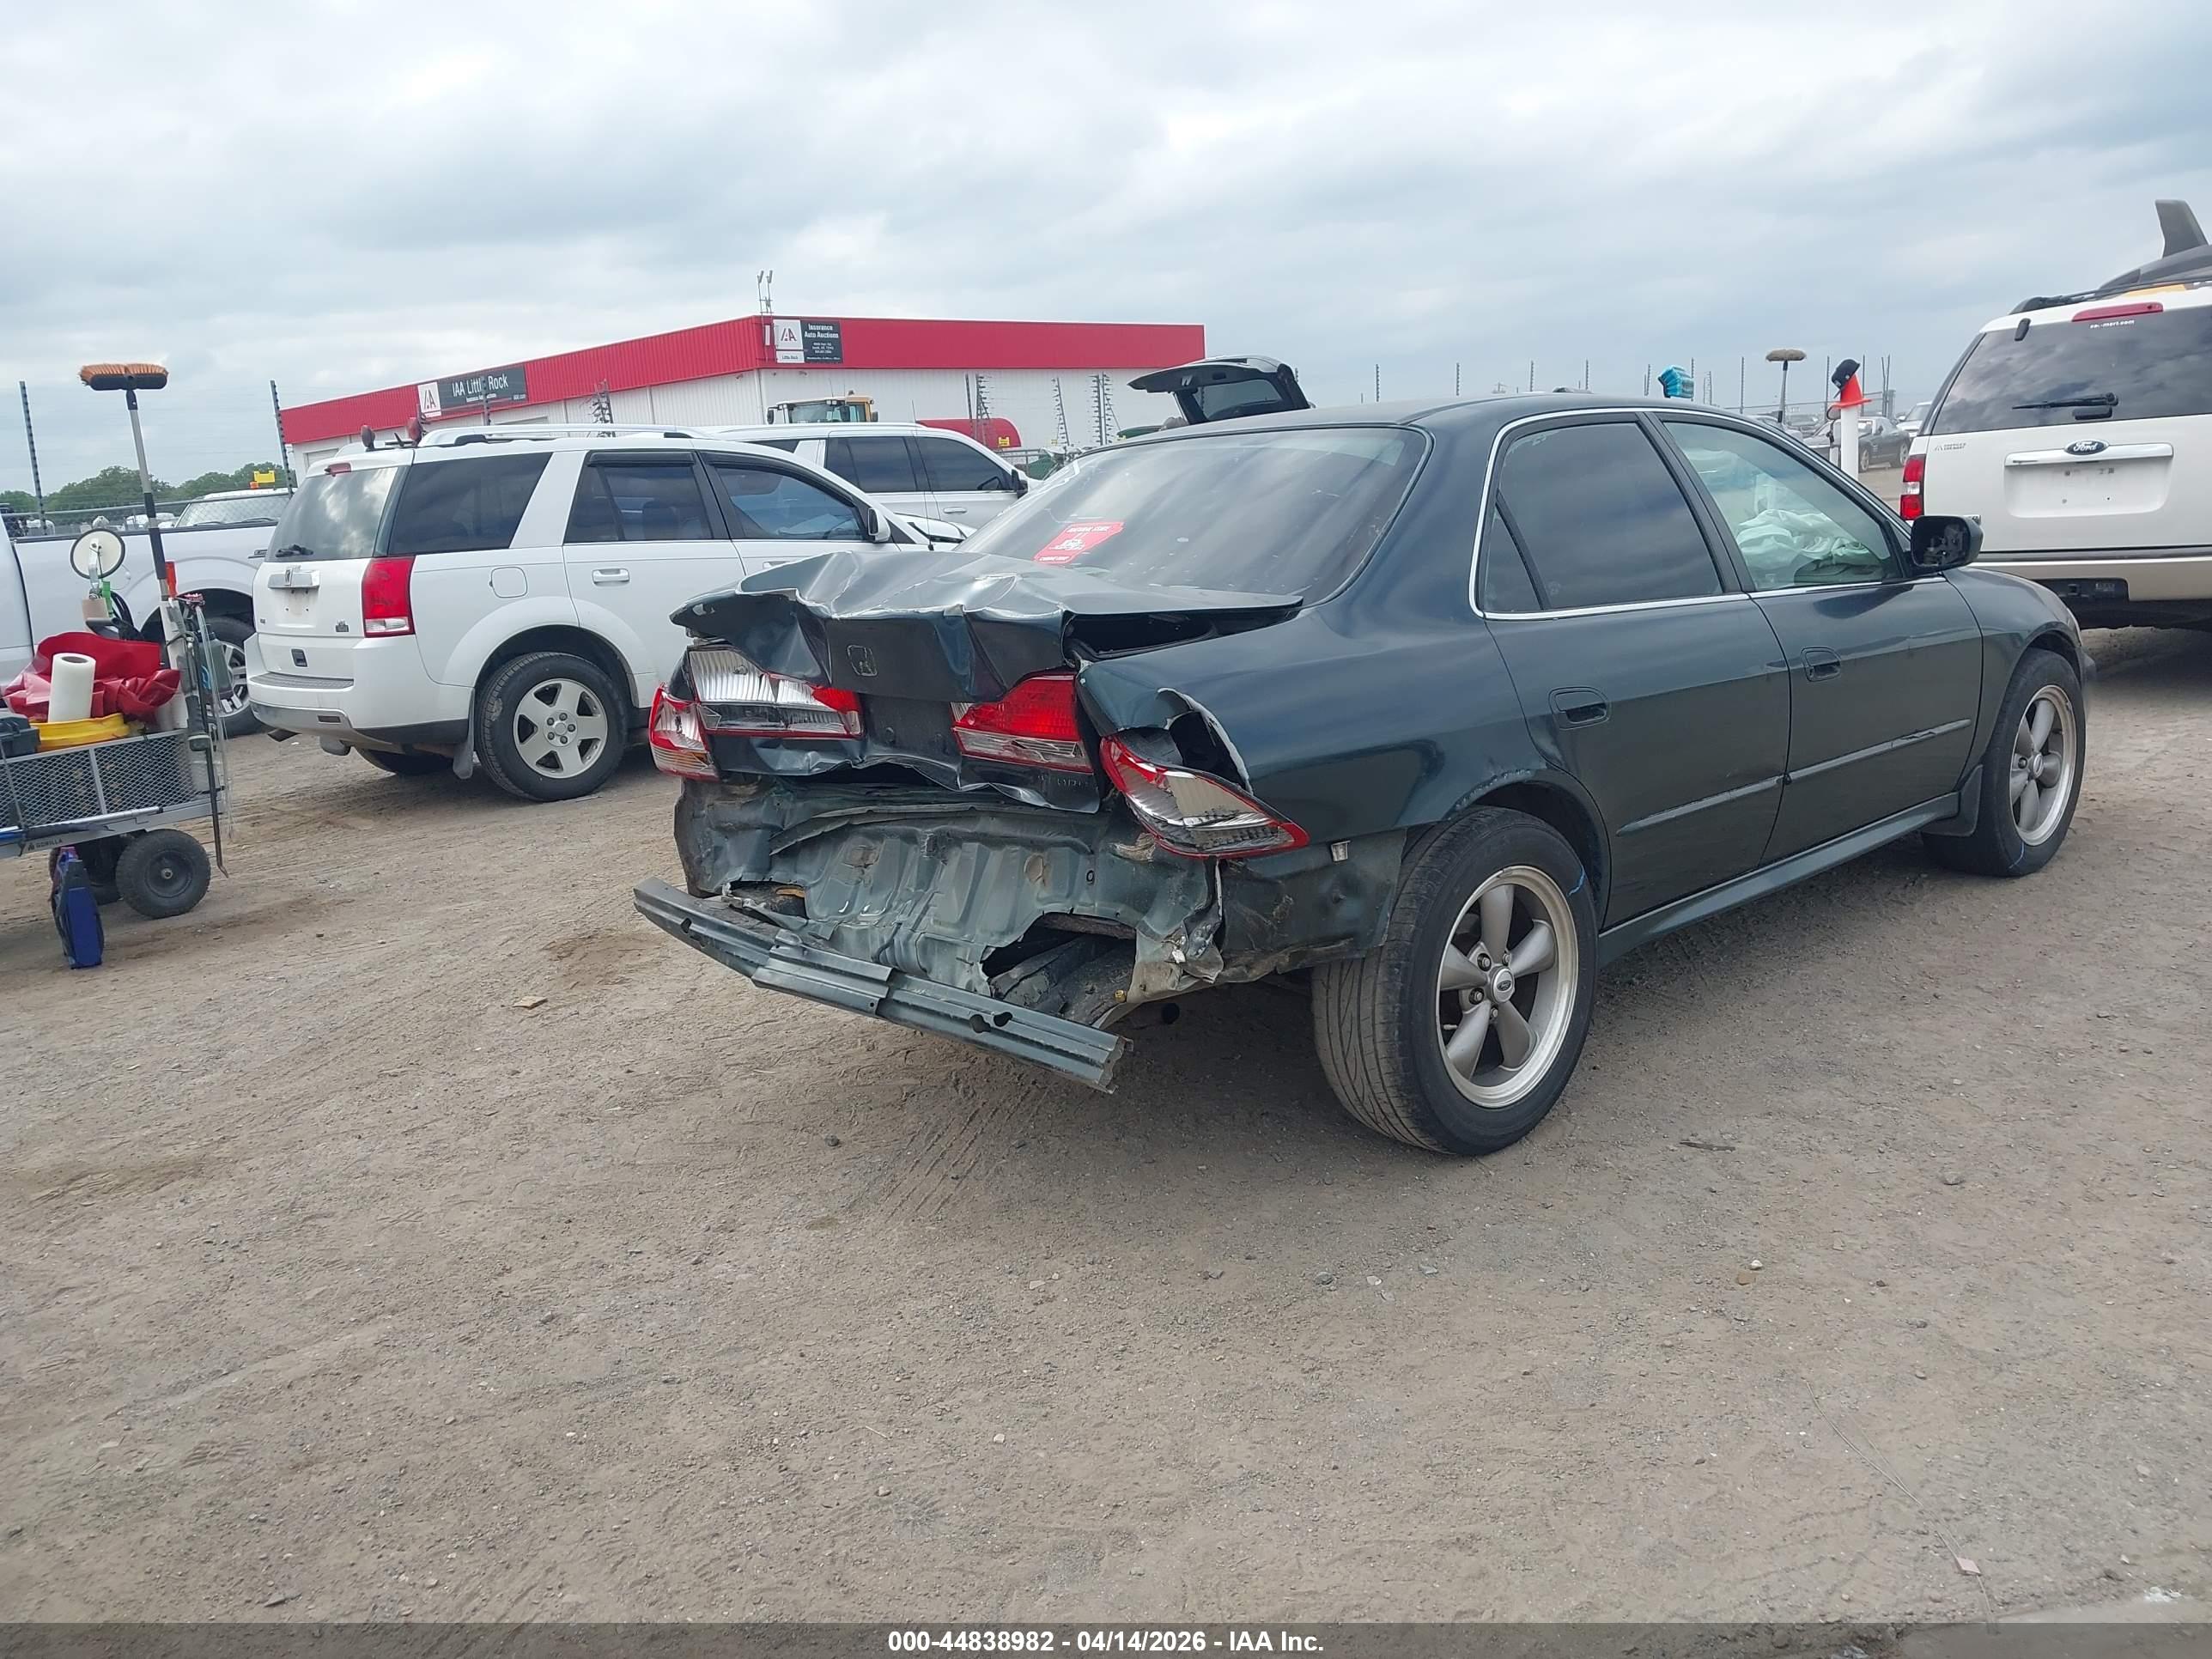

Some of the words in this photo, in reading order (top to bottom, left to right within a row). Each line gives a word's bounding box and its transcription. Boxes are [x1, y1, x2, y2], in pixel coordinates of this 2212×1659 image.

[452, 381, 465, 397] IAA
[466, 378, 486, 394] Littl
[488, 374, 508, 390] Rock
[2073, 441, 2098, 452] Ford
